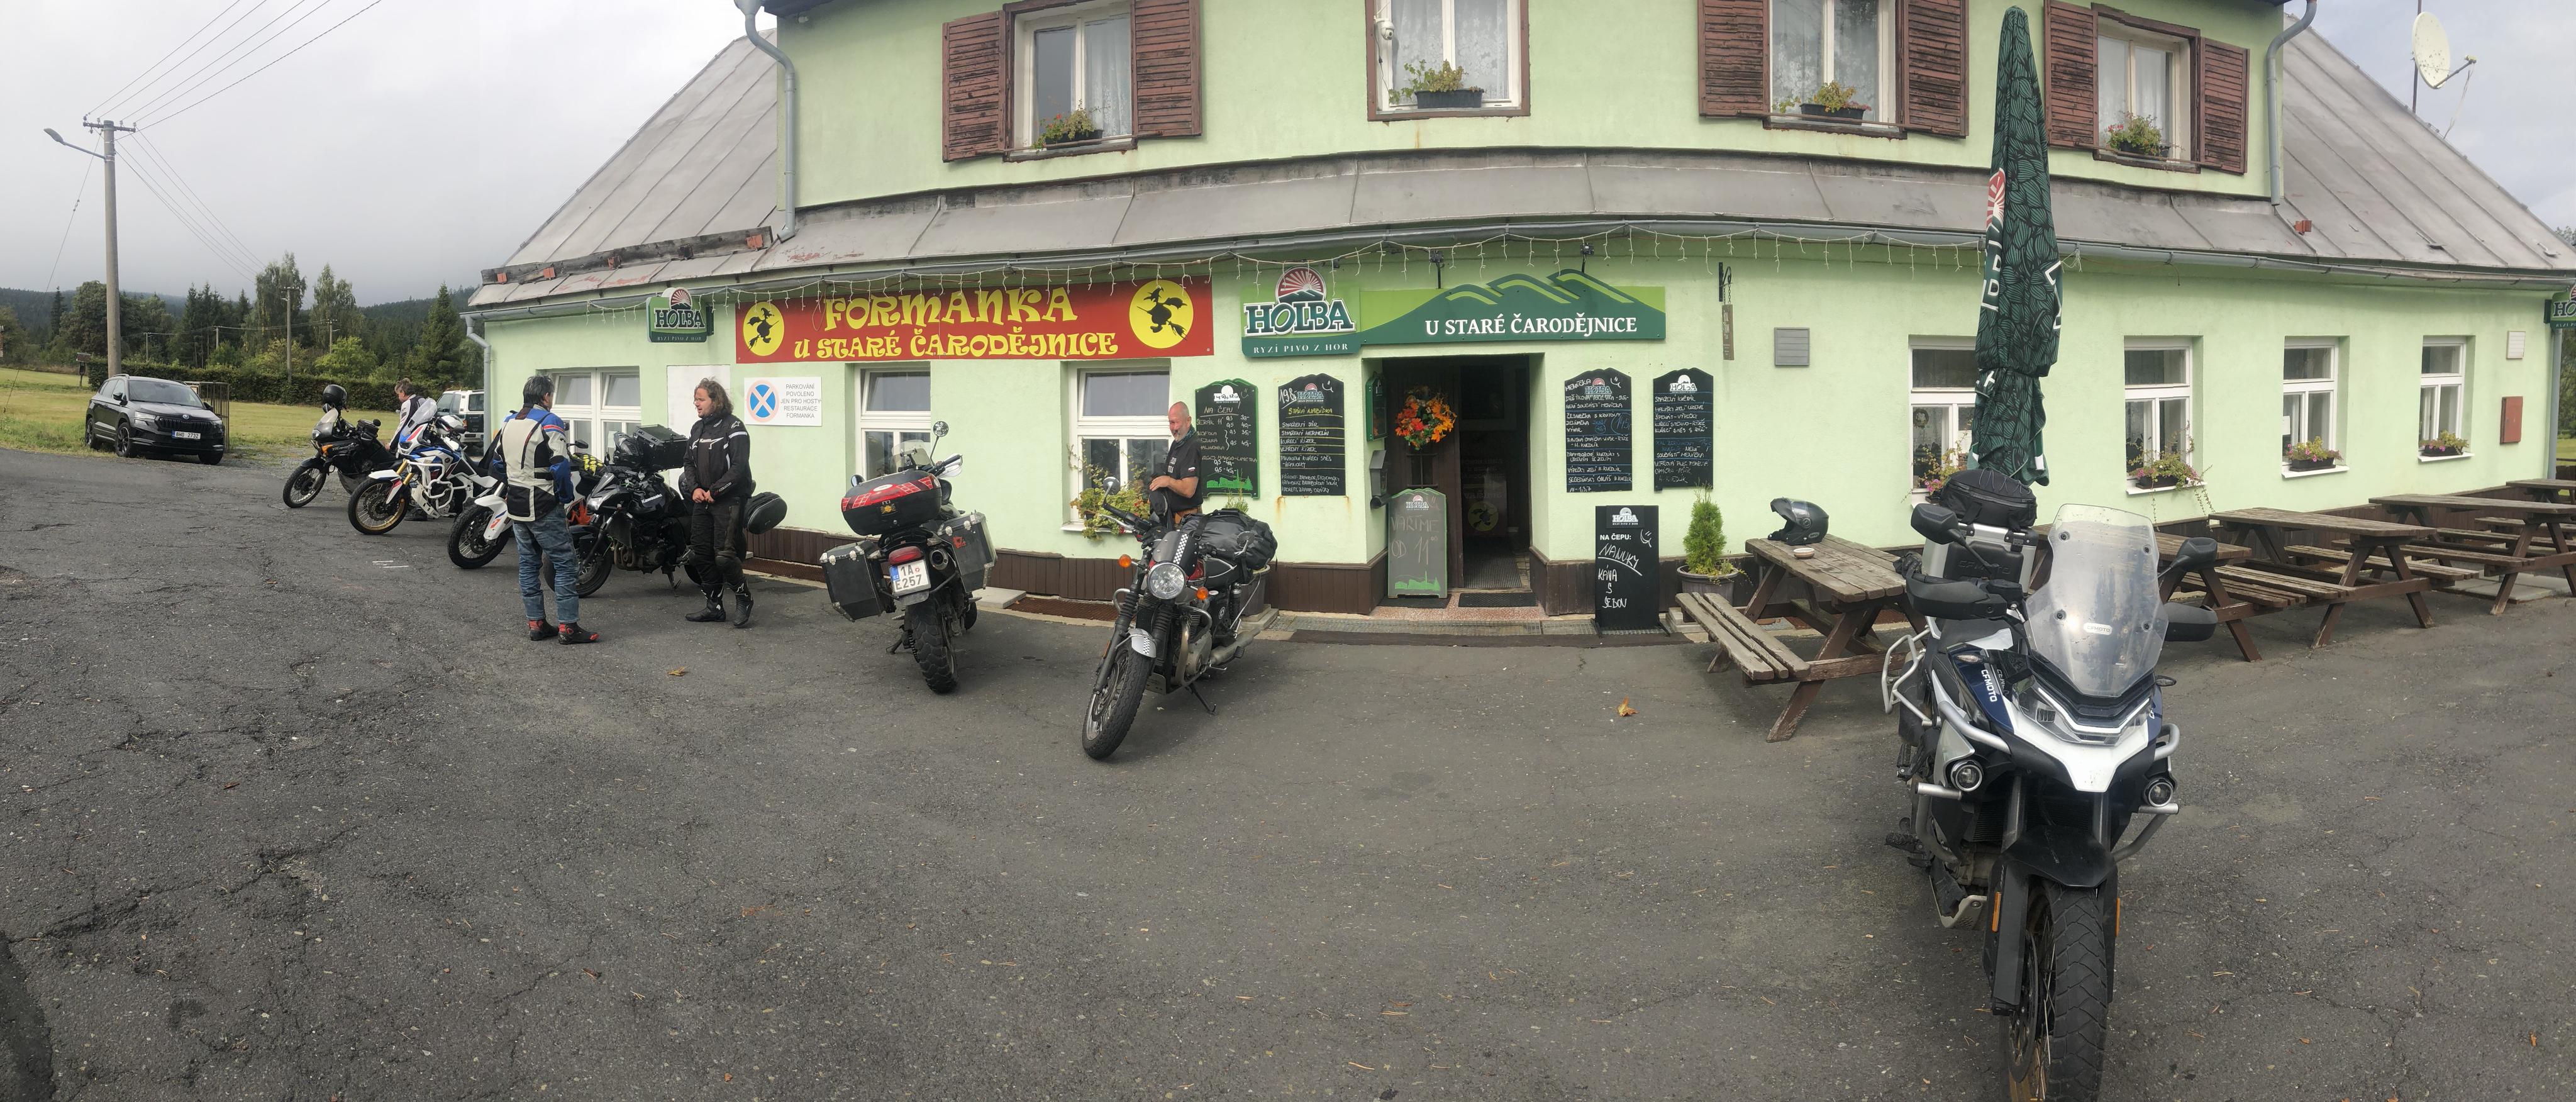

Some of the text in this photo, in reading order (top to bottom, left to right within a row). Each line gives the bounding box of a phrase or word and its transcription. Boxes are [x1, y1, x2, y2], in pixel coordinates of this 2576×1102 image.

[824, 287, 1078, 331] FORMANKA
[2553, 300, 2576, 317] HO
[654, 308, 706, 329] HOLBA
[1243, 298, 1356, 337] HOLBA
[1426, 312, 1637, 337] U STARÉ ČARODĚJNICE
[794, 326, 1118, 359] U STARÉ ČARODĚJNICE
[1253, 343, 1278, 353] RYZÍ
[1284, 344, 1309, 352] PIVO
[1297, 391, 1324, 399] HOLBA
[1585, 386, 1613, 394] HOLBA
[1670, 383, 1697, 391] HOLBA
[901, 564, 914, 576] 1A
[895, 574, 922, 590] E257
[1606, 582, 1613, 594] S
[1981, 669, 1997, 702] CFMOTO
